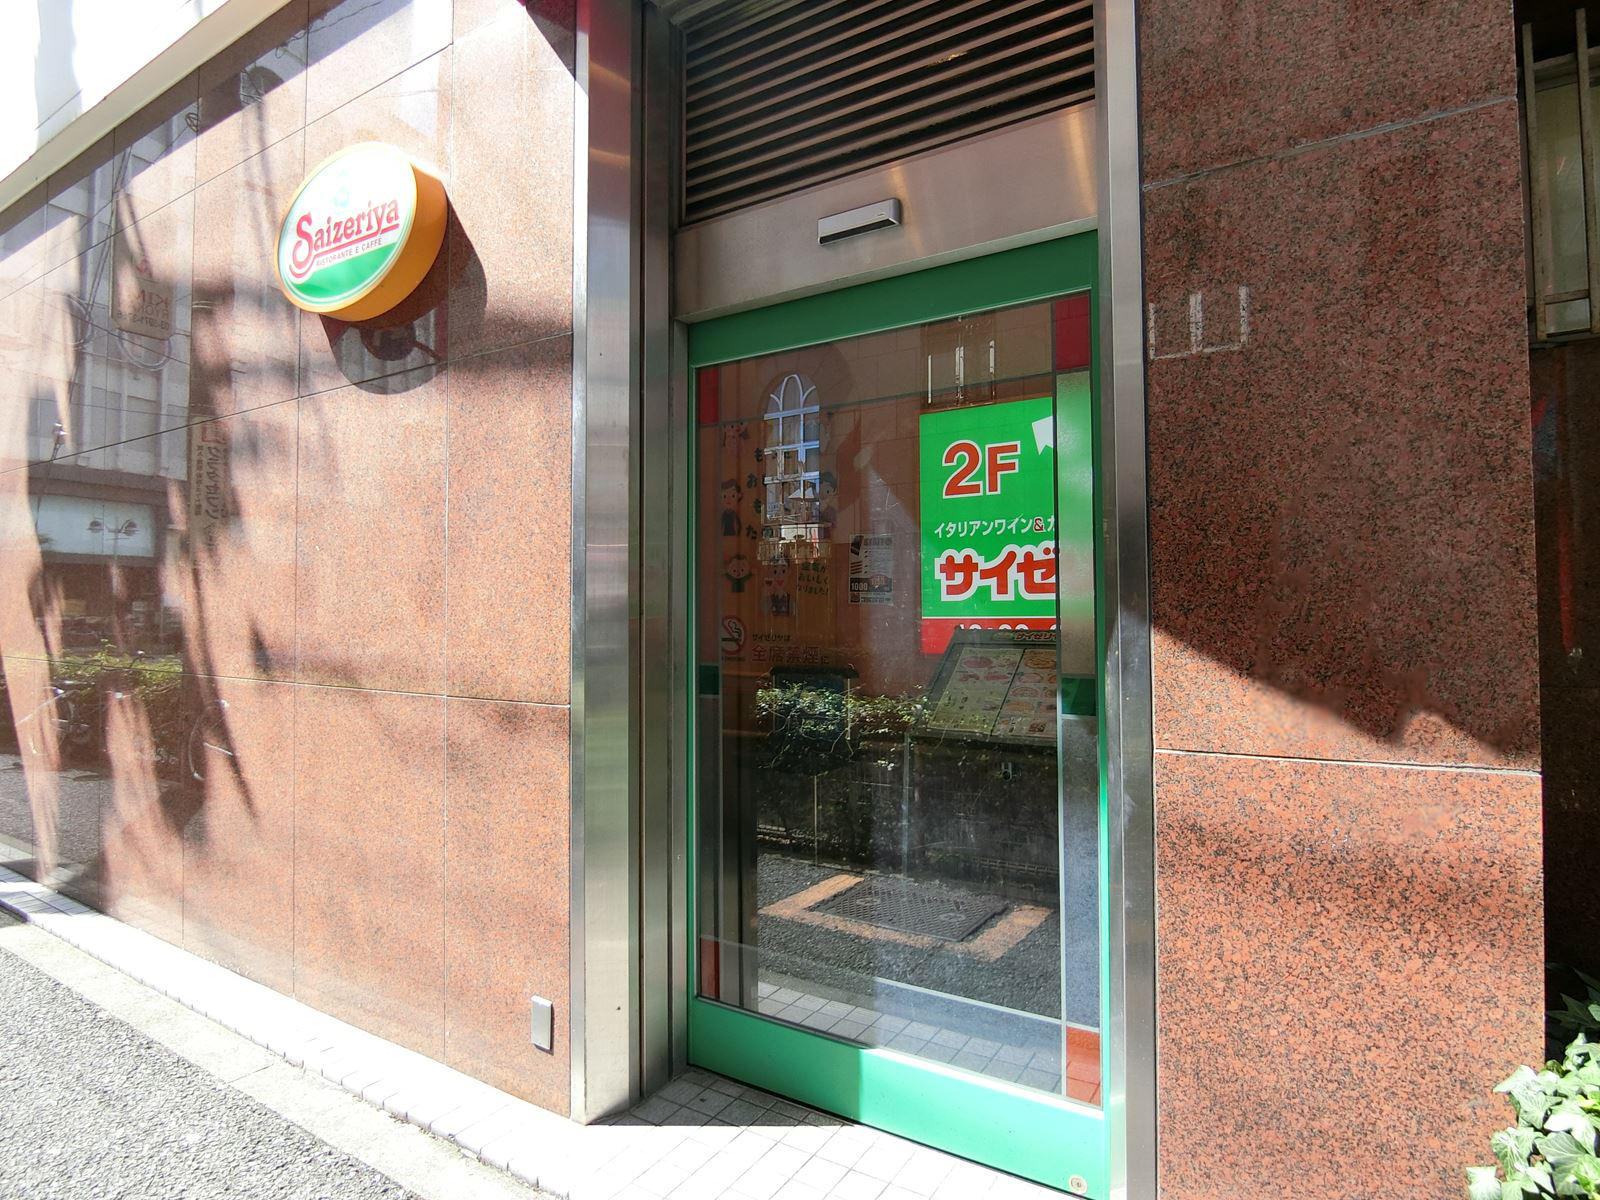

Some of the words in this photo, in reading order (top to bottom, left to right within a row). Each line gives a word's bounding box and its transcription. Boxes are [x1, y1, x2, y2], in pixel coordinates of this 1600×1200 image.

[289, 199, 400, 279] Saizeriya
[942, 440, 1020, 499] 2F
[936, 542, 1057, 601] サイゼ
